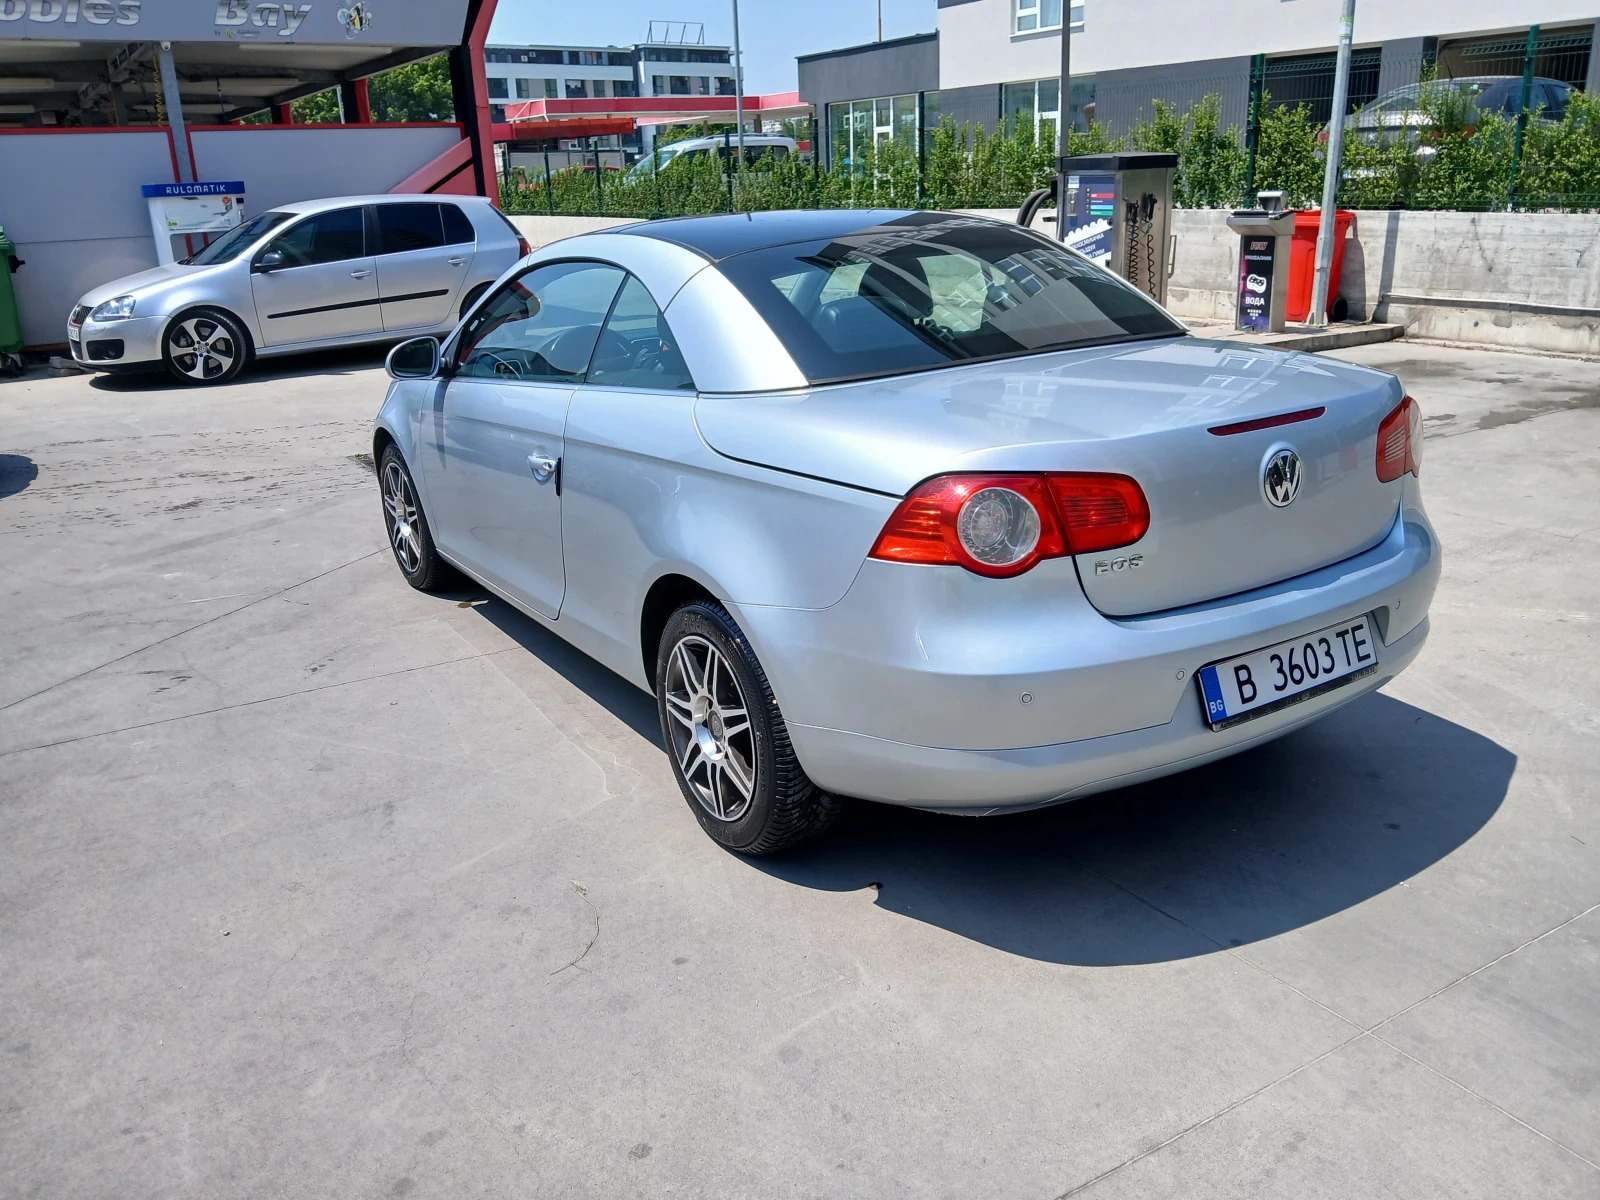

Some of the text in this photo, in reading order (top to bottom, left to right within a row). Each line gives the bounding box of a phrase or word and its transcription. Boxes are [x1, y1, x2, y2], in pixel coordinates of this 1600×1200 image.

[214, 0, 312, 36] Bay
[1245, 296, 1265, 306] ВОДА
[1095, 554, 1144, 576] EOS
[1233, 664, 1257, 704] B
[1269, 637, 1335, 692] 3603
[1335, 624, 1371, 667] TE
[1209, 699, 1224, 714] BG
